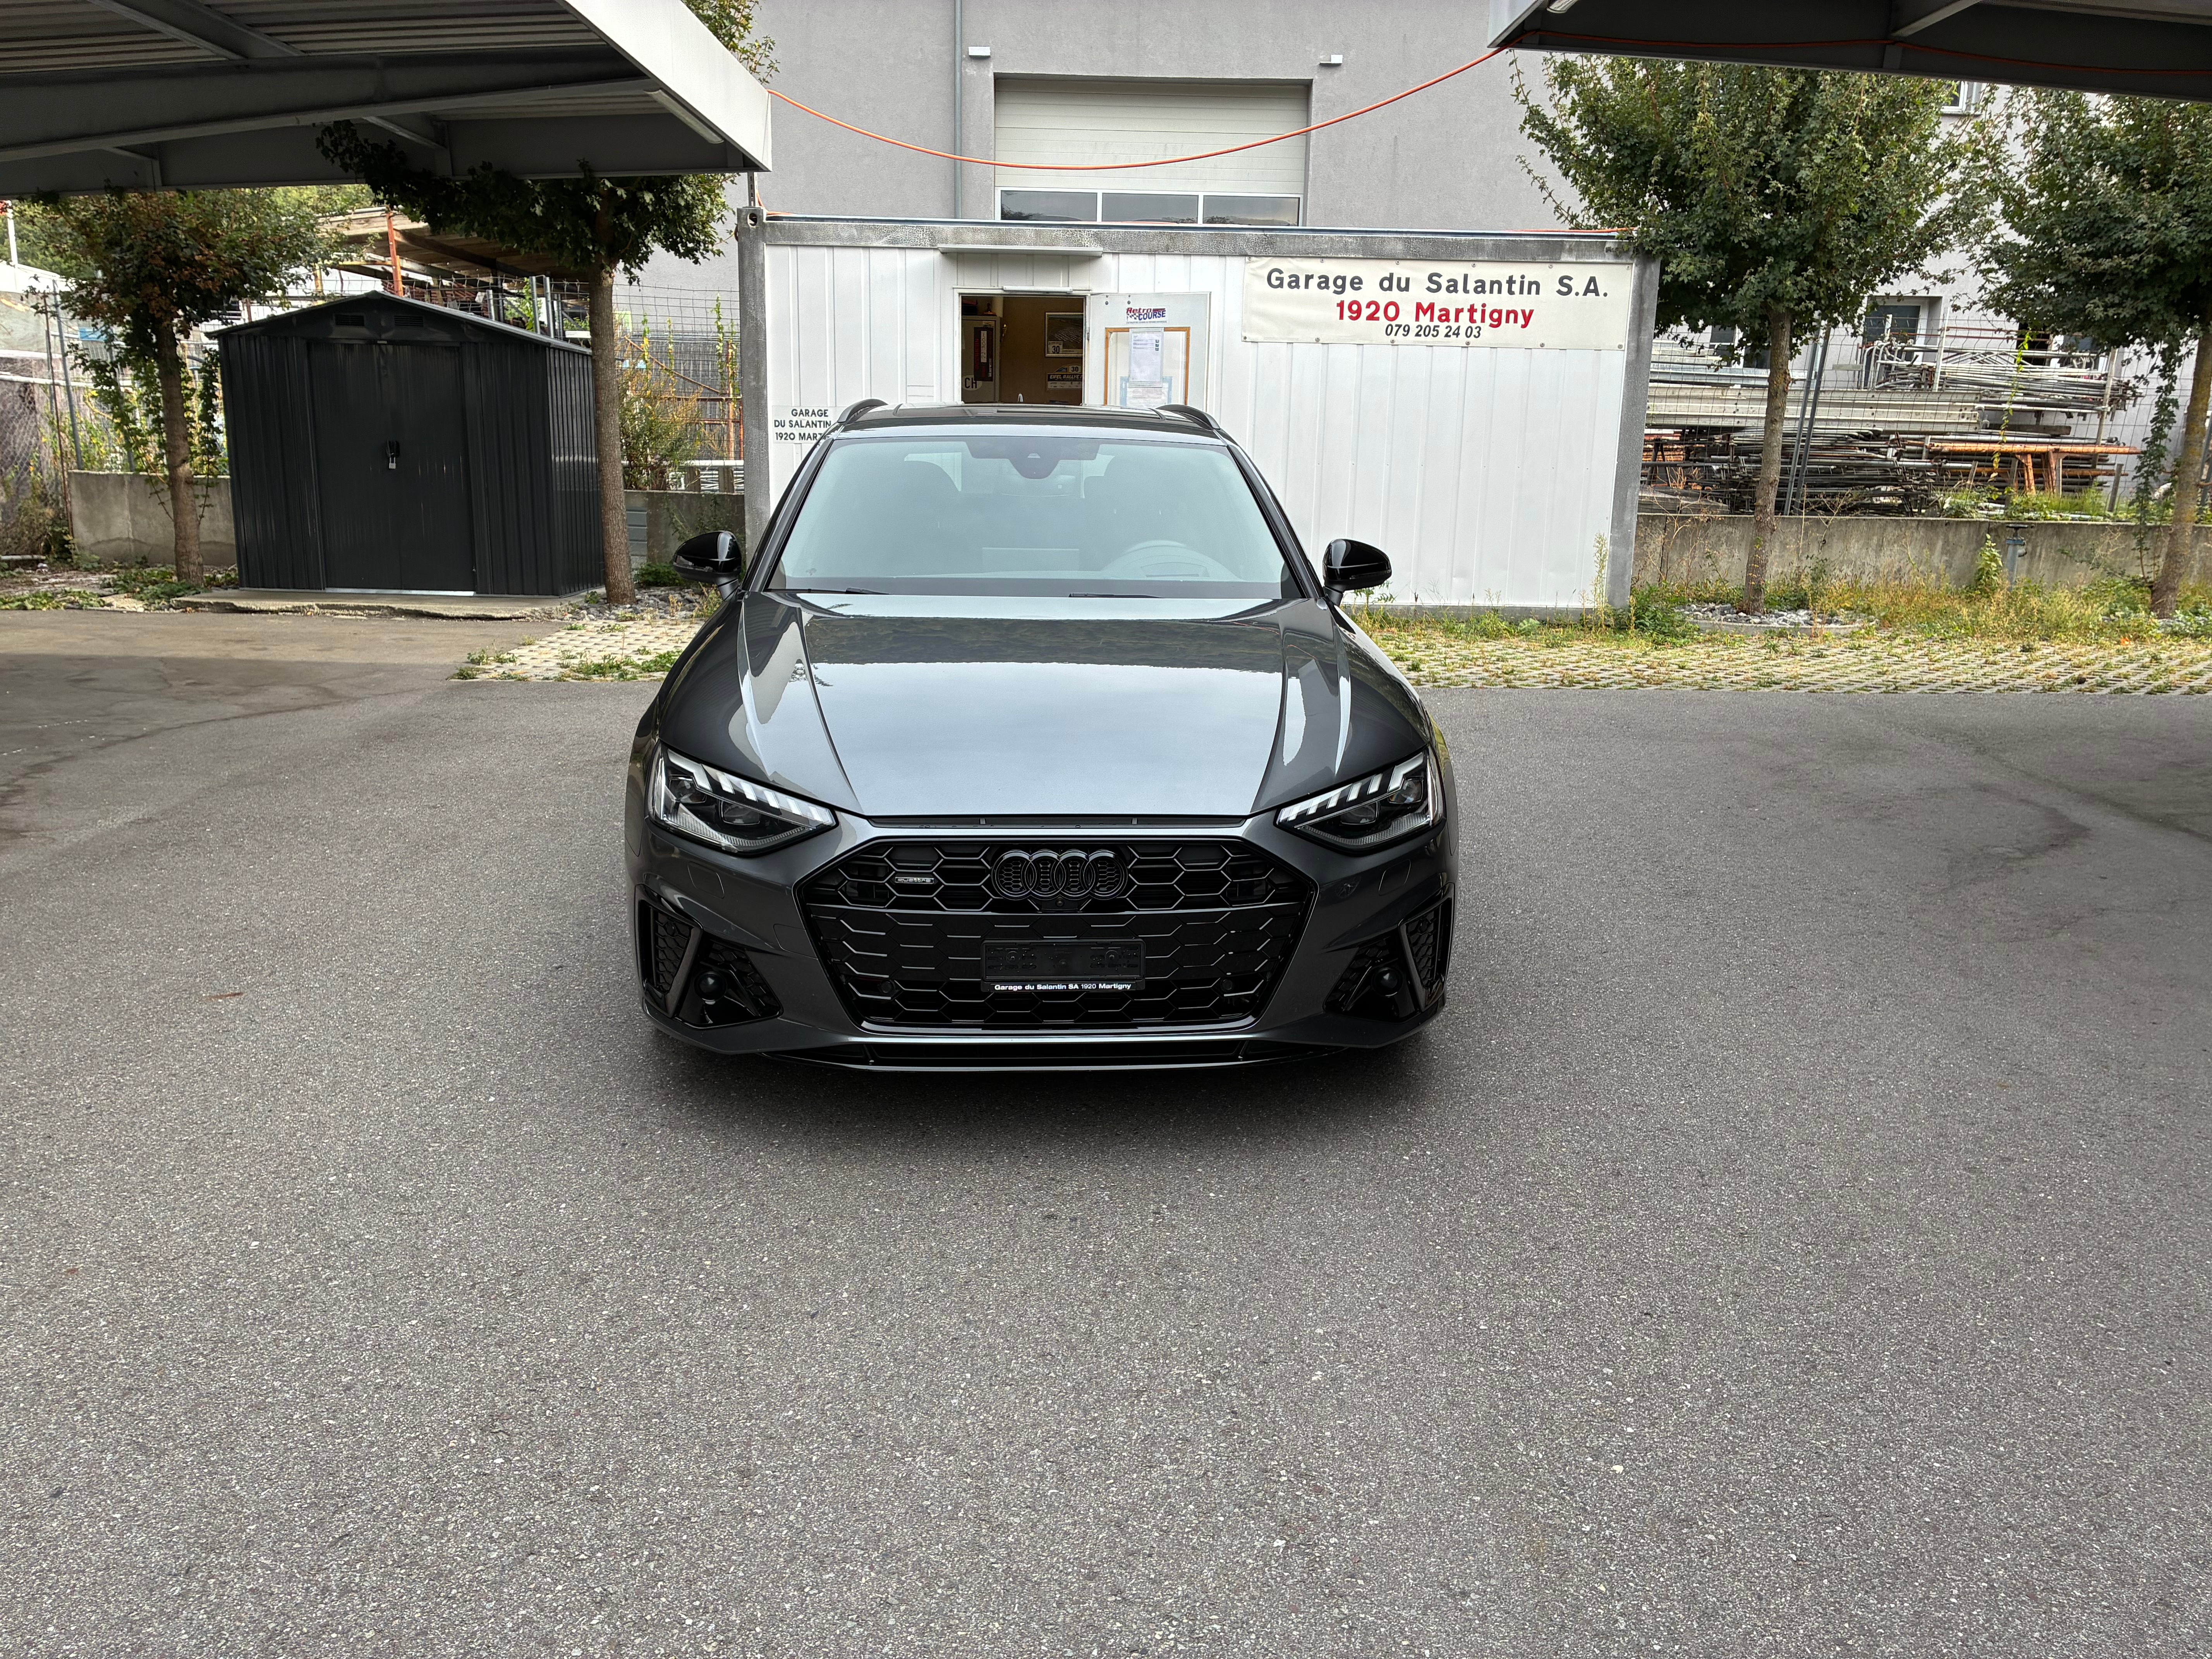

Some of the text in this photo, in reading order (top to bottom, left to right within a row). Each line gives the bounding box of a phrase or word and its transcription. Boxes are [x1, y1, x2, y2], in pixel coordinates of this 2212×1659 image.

[1267, 268, 1608, 297] Garage du Salantin S.A.
[1138, 310, 1166, 321] COURSE
[1337, 300, 1534, 328] 1920 Martigny
[1385, 324, 1482, 338] 079 205 24 03
[1052, 345, 1060, 354] 30
[965, 377, 977, 388] CH
[791, 409, 828, 417] GARAGE
[788, 420, 831, 428] SALANTIN
[775, 432, 795, 440] 1920
